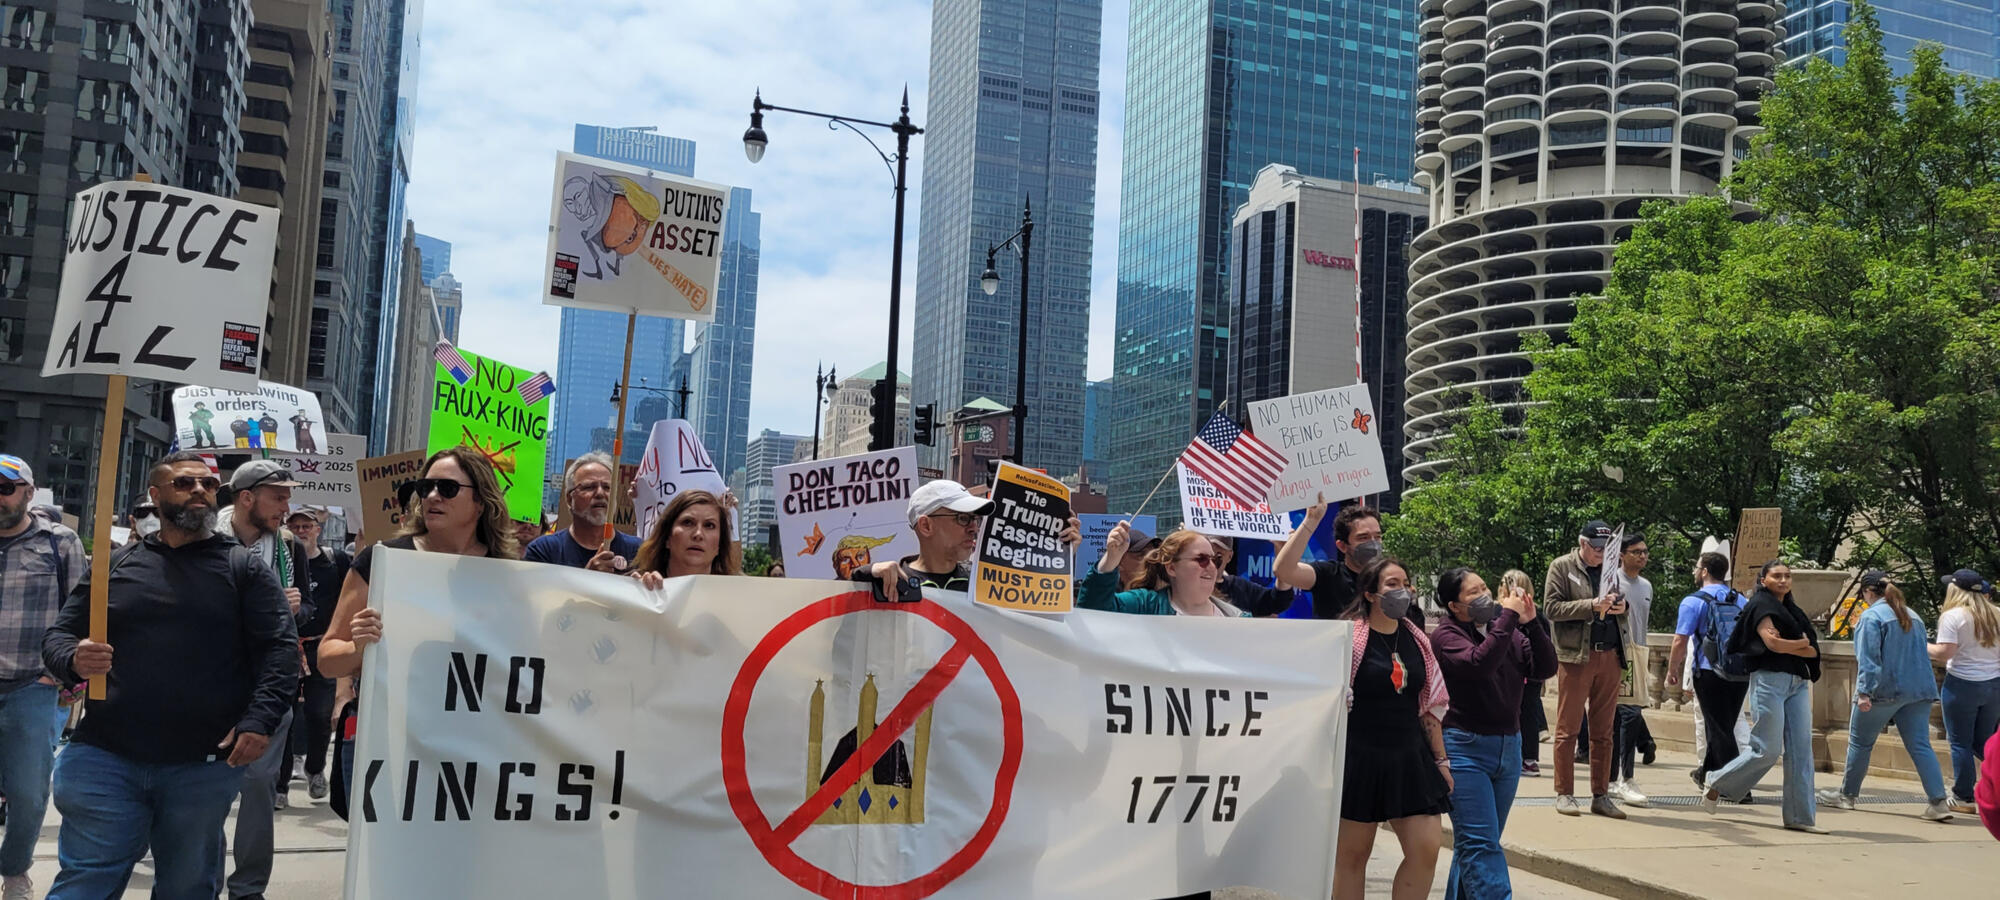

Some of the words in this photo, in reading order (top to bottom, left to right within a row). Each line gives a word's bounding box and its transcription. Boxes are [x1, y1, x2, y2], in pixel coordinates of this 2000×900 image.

[663, 188, 723, 224] PUTIN'S
[68, 190, 258, 271] JUSTICE
[650, 221, 720, 257] ASSET
[85, 253, 132, 327] 4
[648, 252, 670, 276] LIES
[671, 272, 704, 304] HATE
[56, 320, 197, 371] ALL
[475, 356, 515, 394] NO
[179, 386, 216, 399] Just
[227, 386, 299, 406] foowing
[215, 400, 279, 413] orders...
[434, 381, 547, 440] FAUX-KING
[1258, 402, 1280, 428] NO
[1290, 391, 1351, 419] HUMAN
[1280, 422, 1323, 449] BEING
[1333, 415, 1349, 433] IS
[325, 461, 354, 472] 2025
[363, 458, 424, 482] IMMIGRA
[1296, 441, 1356, 469] ILLEGAL
[656, 480, 677, 498] to
[789, 466, 835, 493] DON
[846, 456, 900, 483] TACO
[1273, 478, 1313, 500] Chinga
[1321, 468, 1332, 485] la
[1337, 467, 1373, 488] migra
[783, 478, 912, 516] CHEETOLINI
[1024, 490, 1047, 508] The
[1203, 498, 1231, 510] TOLD
[1001, 498, 1064, 536] Trump
[1191, 507, 1203, 517] IN
[1206, 508, 1229, 520] THE
[1233, 511, 1282, 525] HISTORY
[1192, 517, 1207, 528] OF
[1212, 519, 1235, 531] THE
[1238, 522, 1285, 535] WORLD.
[985, 537, 1065, 569] Regime
[991, 518, 1064, 553] Fascist
[982, 568, 1034, 588] MUST
[1040, 578, 1066, 590] GO
[988, 584, 1060, 606] NOW!!!
[445, 652, 545, 714] NO
[1105, 683, 1268, 736] SINCE
[363, 750, 625, 822] KINGS!
[1127, 775, 1241, 823] 1776
